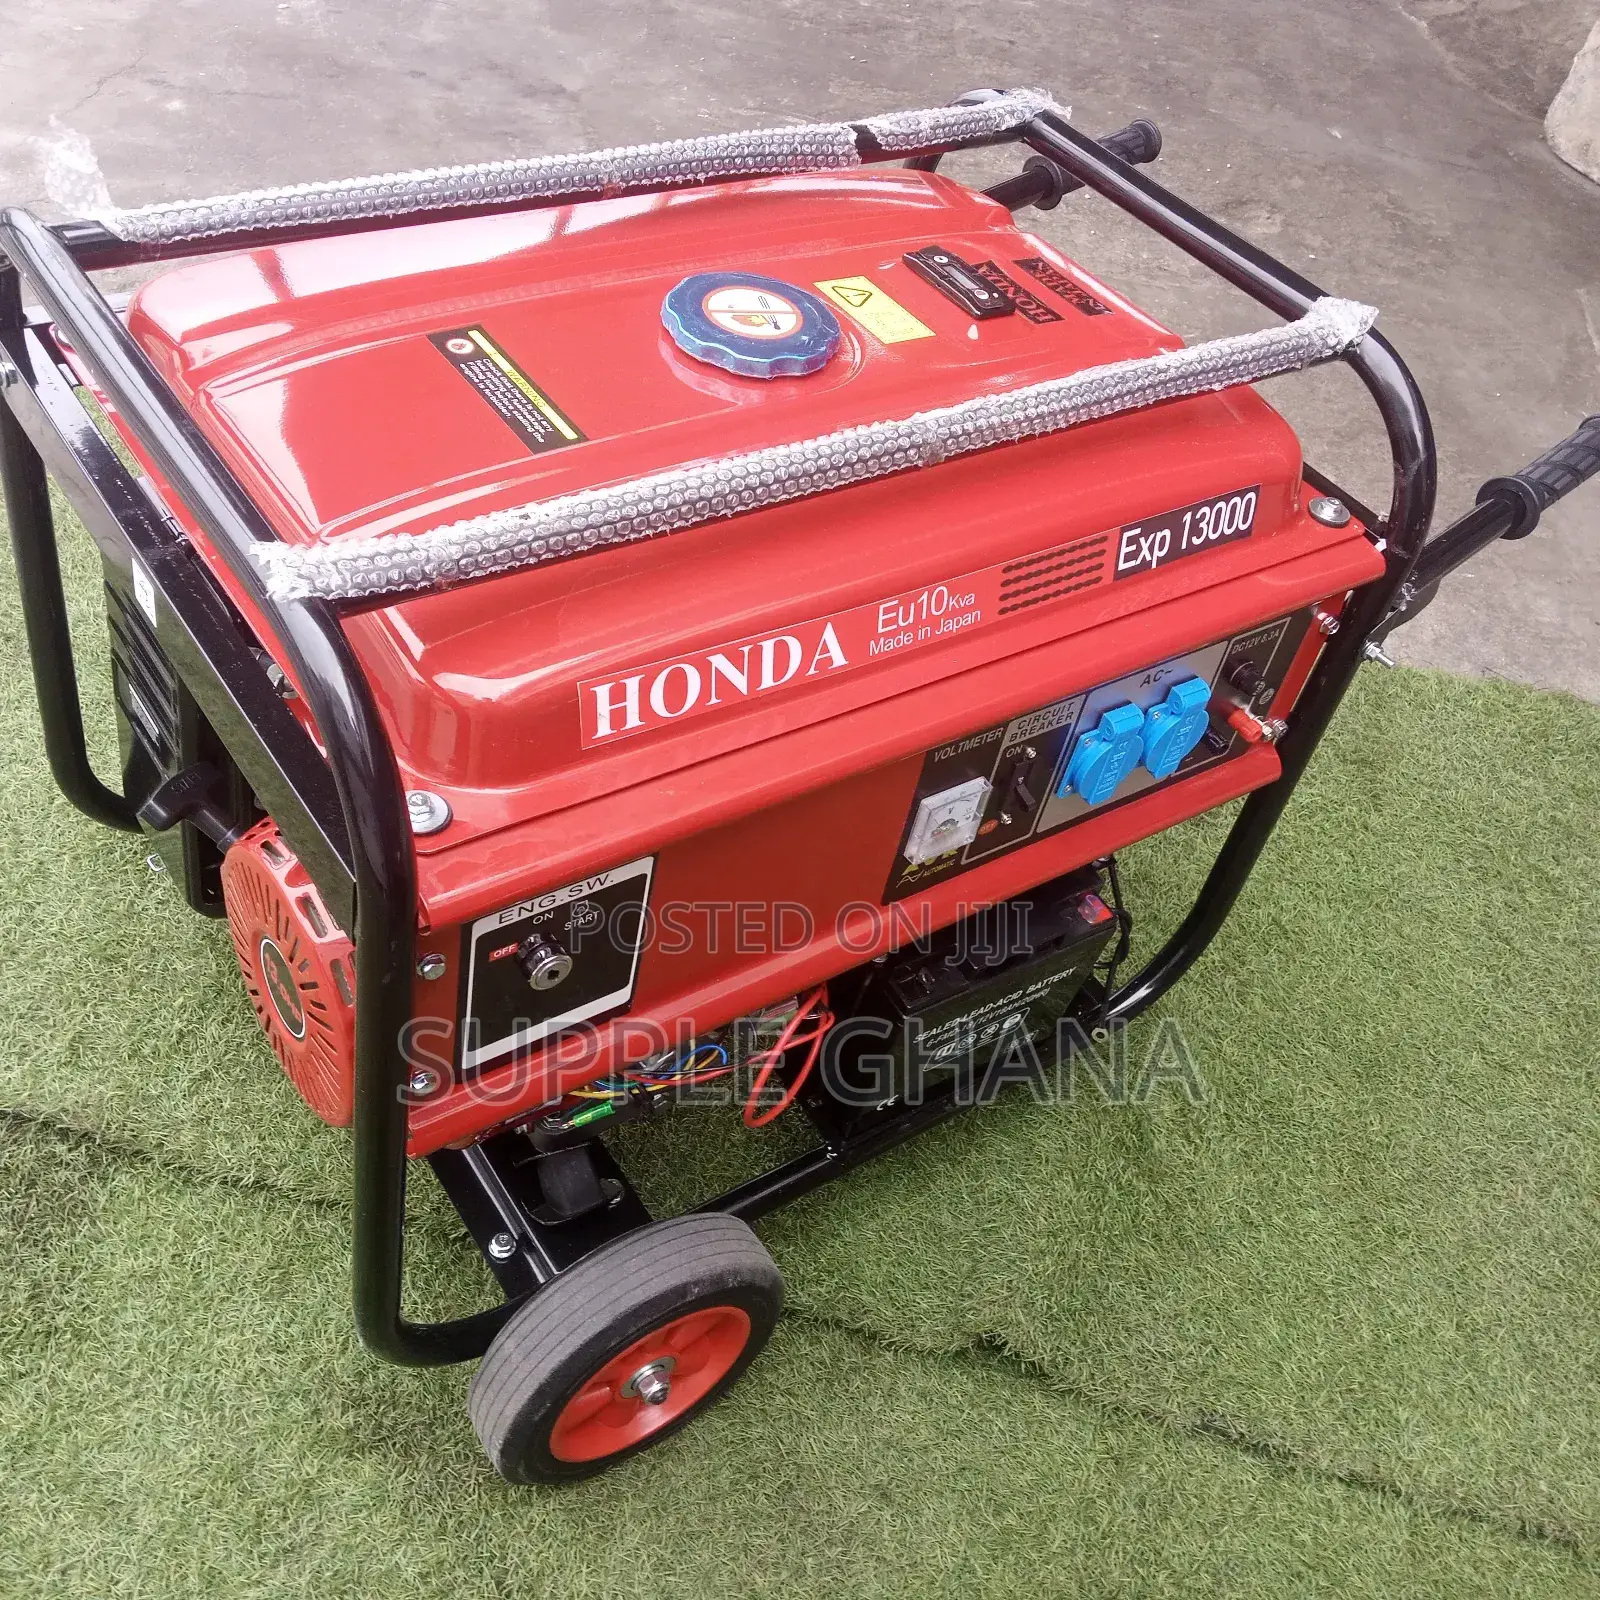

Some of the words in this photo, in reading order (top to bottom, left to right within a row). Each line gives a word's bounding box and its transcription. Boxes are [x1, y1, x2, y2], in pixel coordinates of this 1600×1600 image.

[460, 363, 480, 383] engine
[475, 360, 489, 372] fuel
[483, 358, 502, 376] Check
[500, 376, 513, 388] that
[511, 388, 527, 404] there
[531, 410, 543, 420] not
[540, 420, 554, 432] any
[507, 369, 546, 408] WARNING
[484, 379, 498, 391] fuel
[494, 390, 514, 410] before
[533, 432, 545, 443] the
[1118, 527, 1171, 569] Exp
[1181, 491, 1256, 550] 13000
[869, 631, 914, 656] Made
[918, 625, 931, 640] in
[935, 610, 981, 635] Japan
[590, 622, 849, 740] HONDA
[1009, 711, 1074, 742] BREAKER
[1017, 701, 1075, 730] CIRCUIT
[935, 727, 1004, 762] VOLTMETER
[1006, 745, 1022, 758] ON
[922, 859, 956, 878] AUTOMATIC
[498, 874, 614, 924] ENG.SW.
[532, 911, 554, 925] ON
[564, 910, 600, 931] START
[493, 944, 516, 958] OFF
[1026, 966, 1077, 994] BATTERY
[876, 1094, 899, 1111] CE
